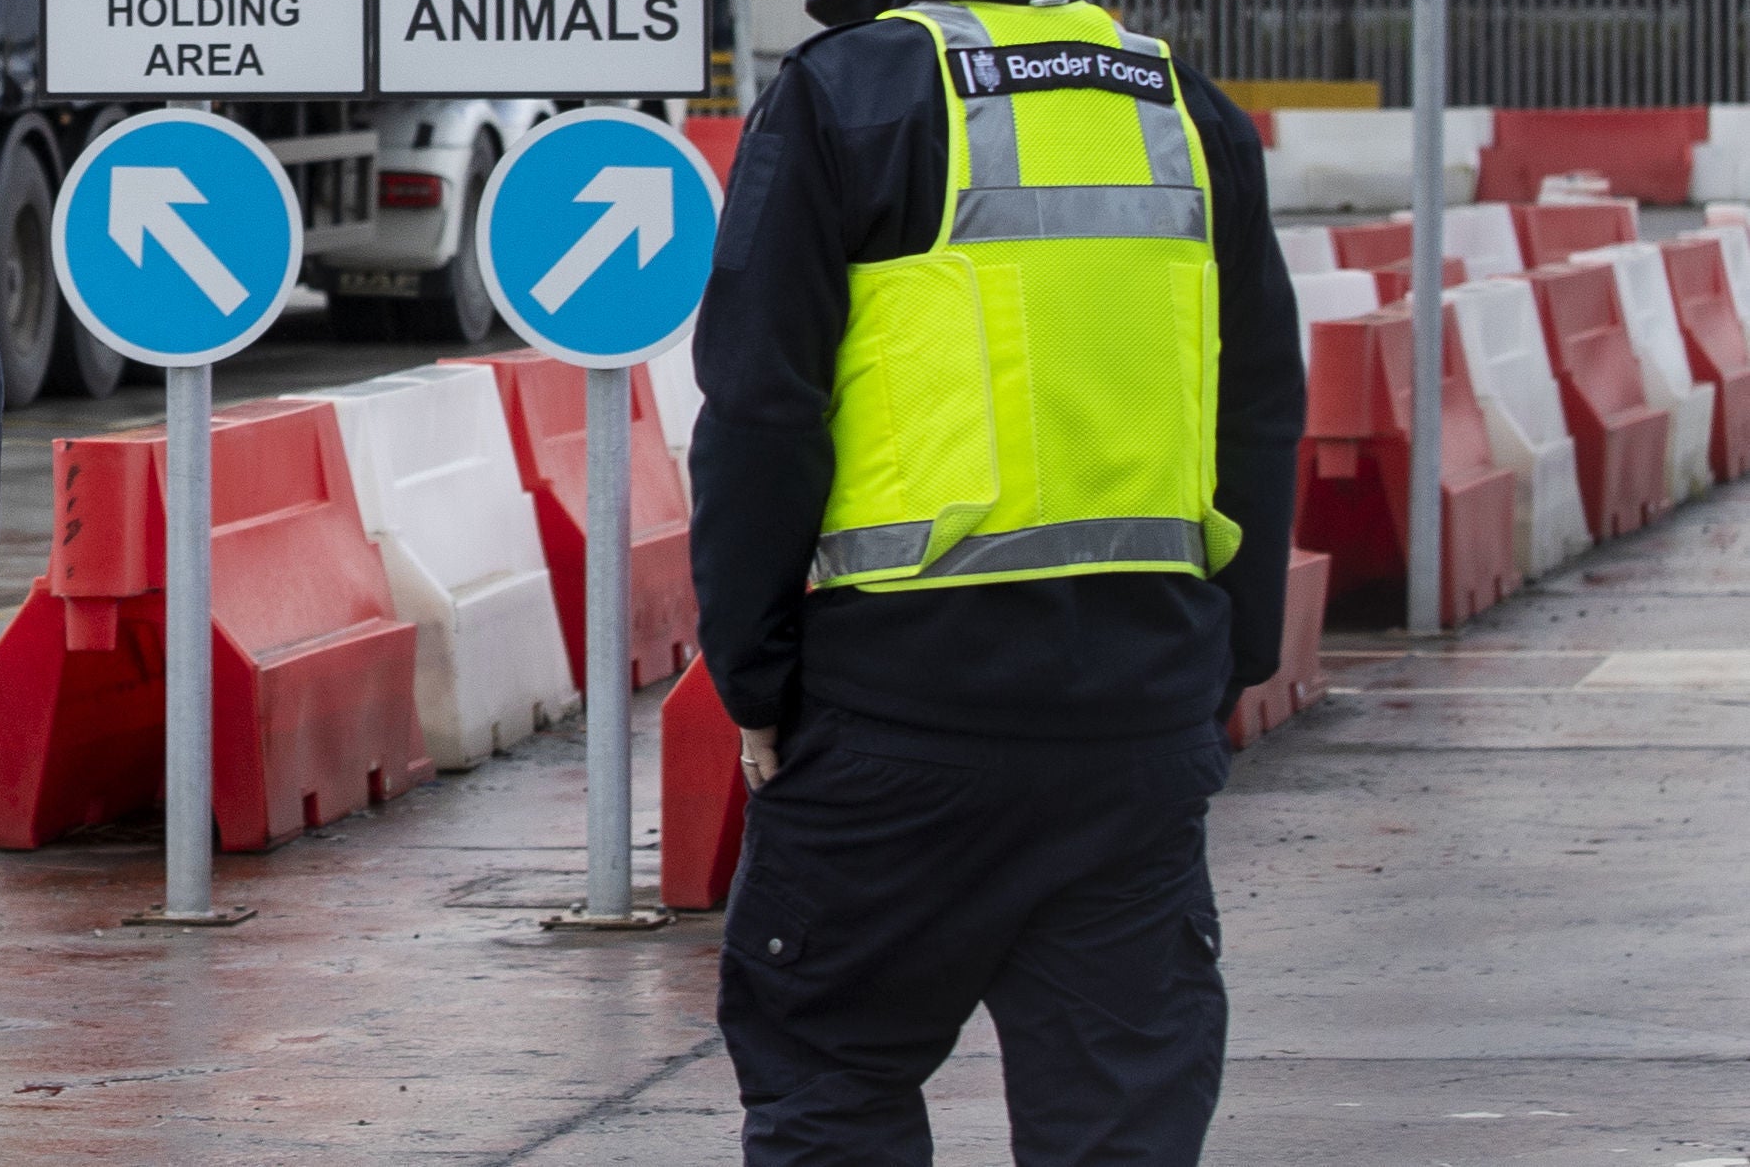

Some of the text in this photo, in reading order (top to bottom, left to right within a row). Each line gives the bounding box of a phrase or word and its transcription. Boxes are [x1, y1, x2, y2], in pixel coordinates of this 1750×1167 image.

[144, 43, 265, 77] AREA
[1006, 52, 1164, 89] Border Force
